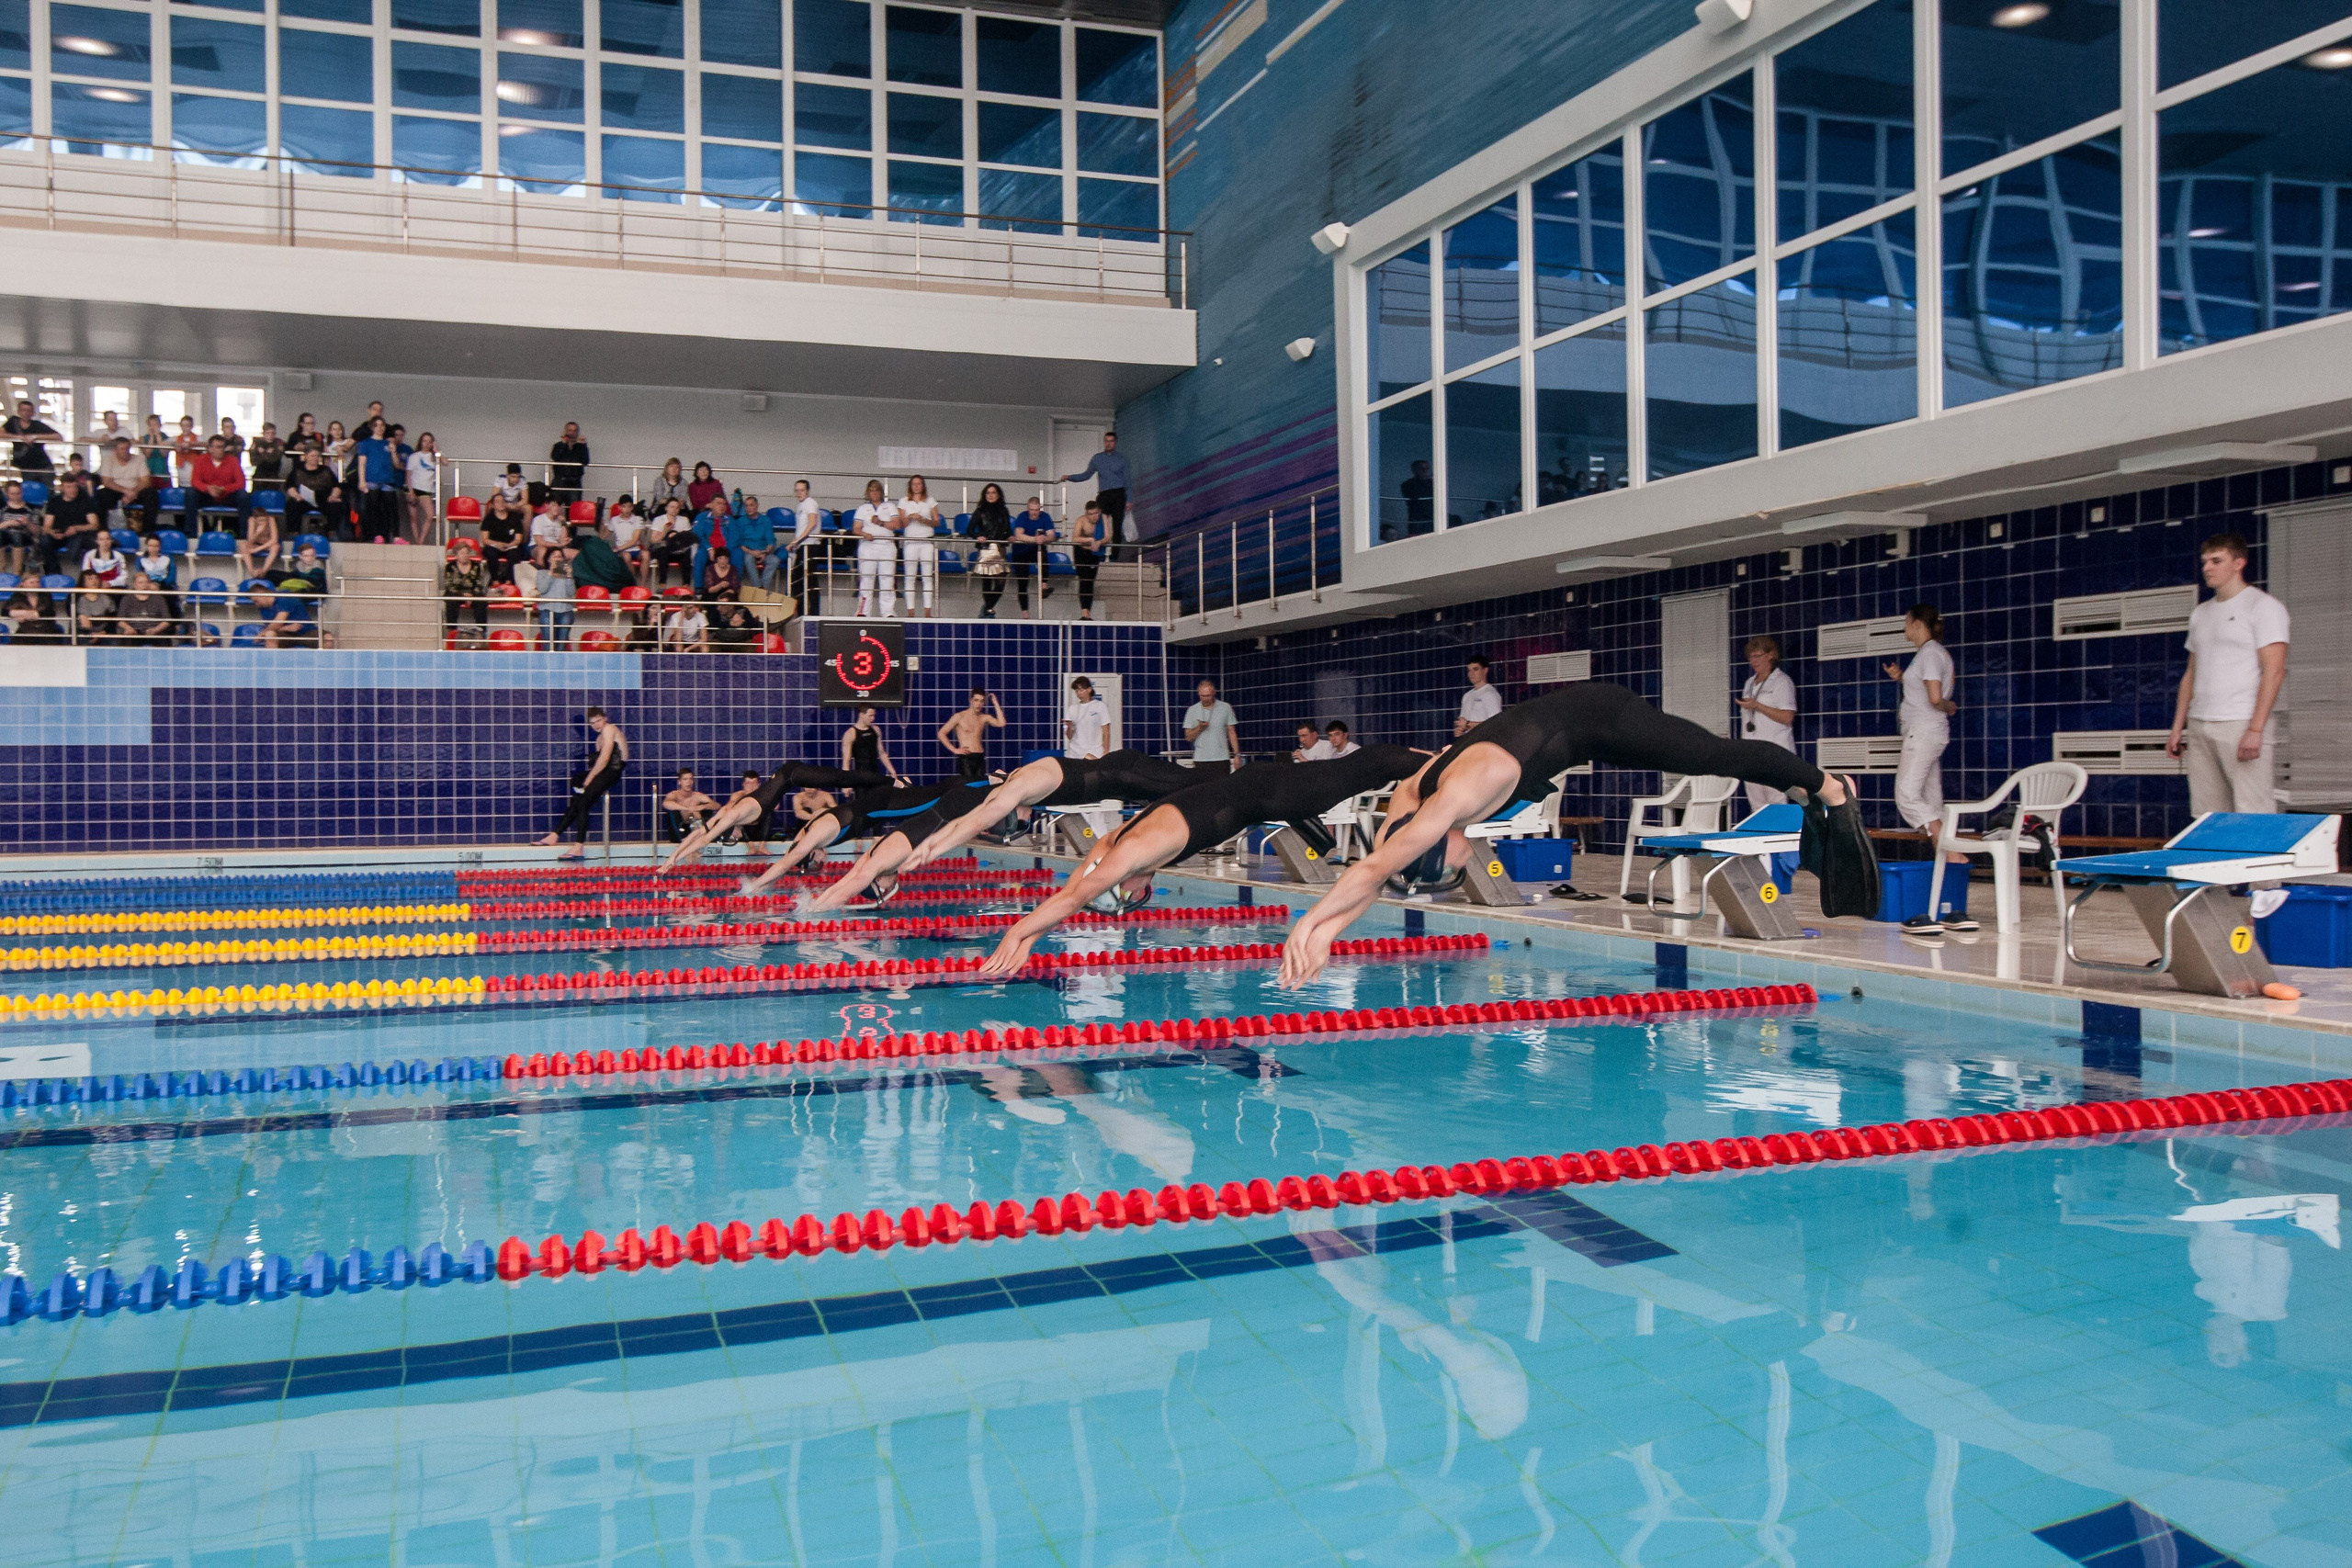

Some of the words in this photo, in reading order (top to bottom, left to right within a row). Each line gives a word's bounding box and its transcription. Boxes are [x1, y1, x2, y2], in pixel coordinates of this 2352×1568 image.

[854, 651, 873, 675] 3
[1491, 864, 1498, 874] 5
[1765, 887, 1772, 899] 6
[2235, 932, 2246, 949] 7
